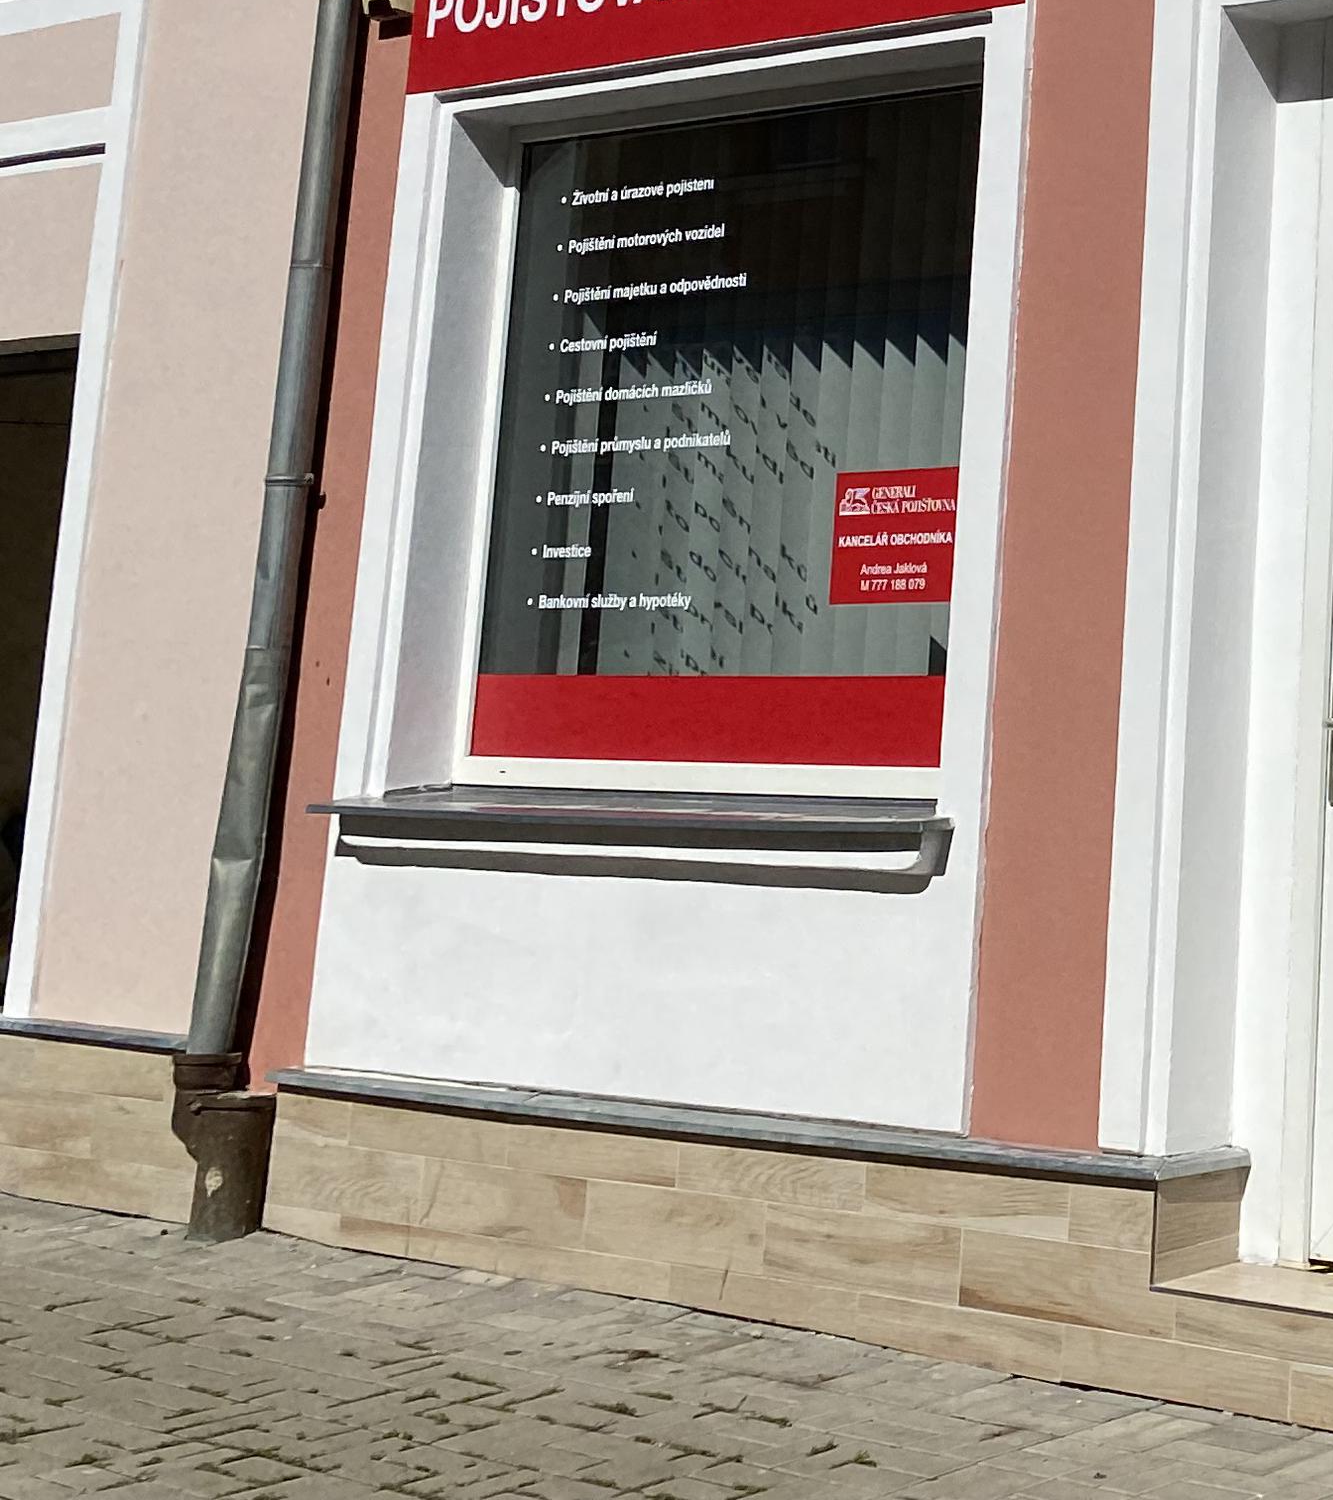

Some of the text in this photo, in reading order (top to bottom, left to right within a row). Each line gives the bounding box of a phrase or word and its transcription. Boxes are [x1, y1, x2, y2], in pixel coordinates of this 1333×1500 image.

[571, 188, 610, 206] Životní
[611, 191, 618, 201] a
[621, 182, 664, 200] úrazové
[568, 223, 725, 255] Pojištění motorových vozidel
[563, 273, 747, 305] Pojištění majetku a odpovědnosti
[560, 330, 657, 353] Cestovní pojištění
[555, 379, 712, 406] Pojištění domácích mazlíčků
[551, 430, 731, 457] Pojištění průmyslu a podnikatelů
[547, 487, 634, 508] Penzijní spoření
[872, 485, 916, 499] GENERALI
[871, 496, 956, 515] ČESKÁ POJIŠŤOVNA
[838, 529, 953, 548] KANCELÁŘ OBCHODNÍKA
[542, 544, 592, 558] Investice
[860, 563, 892, 576] Andrea
[871, 579, 888, 591] 777
[538, 592, 691, 611] Bankovní služby a hypotéky
